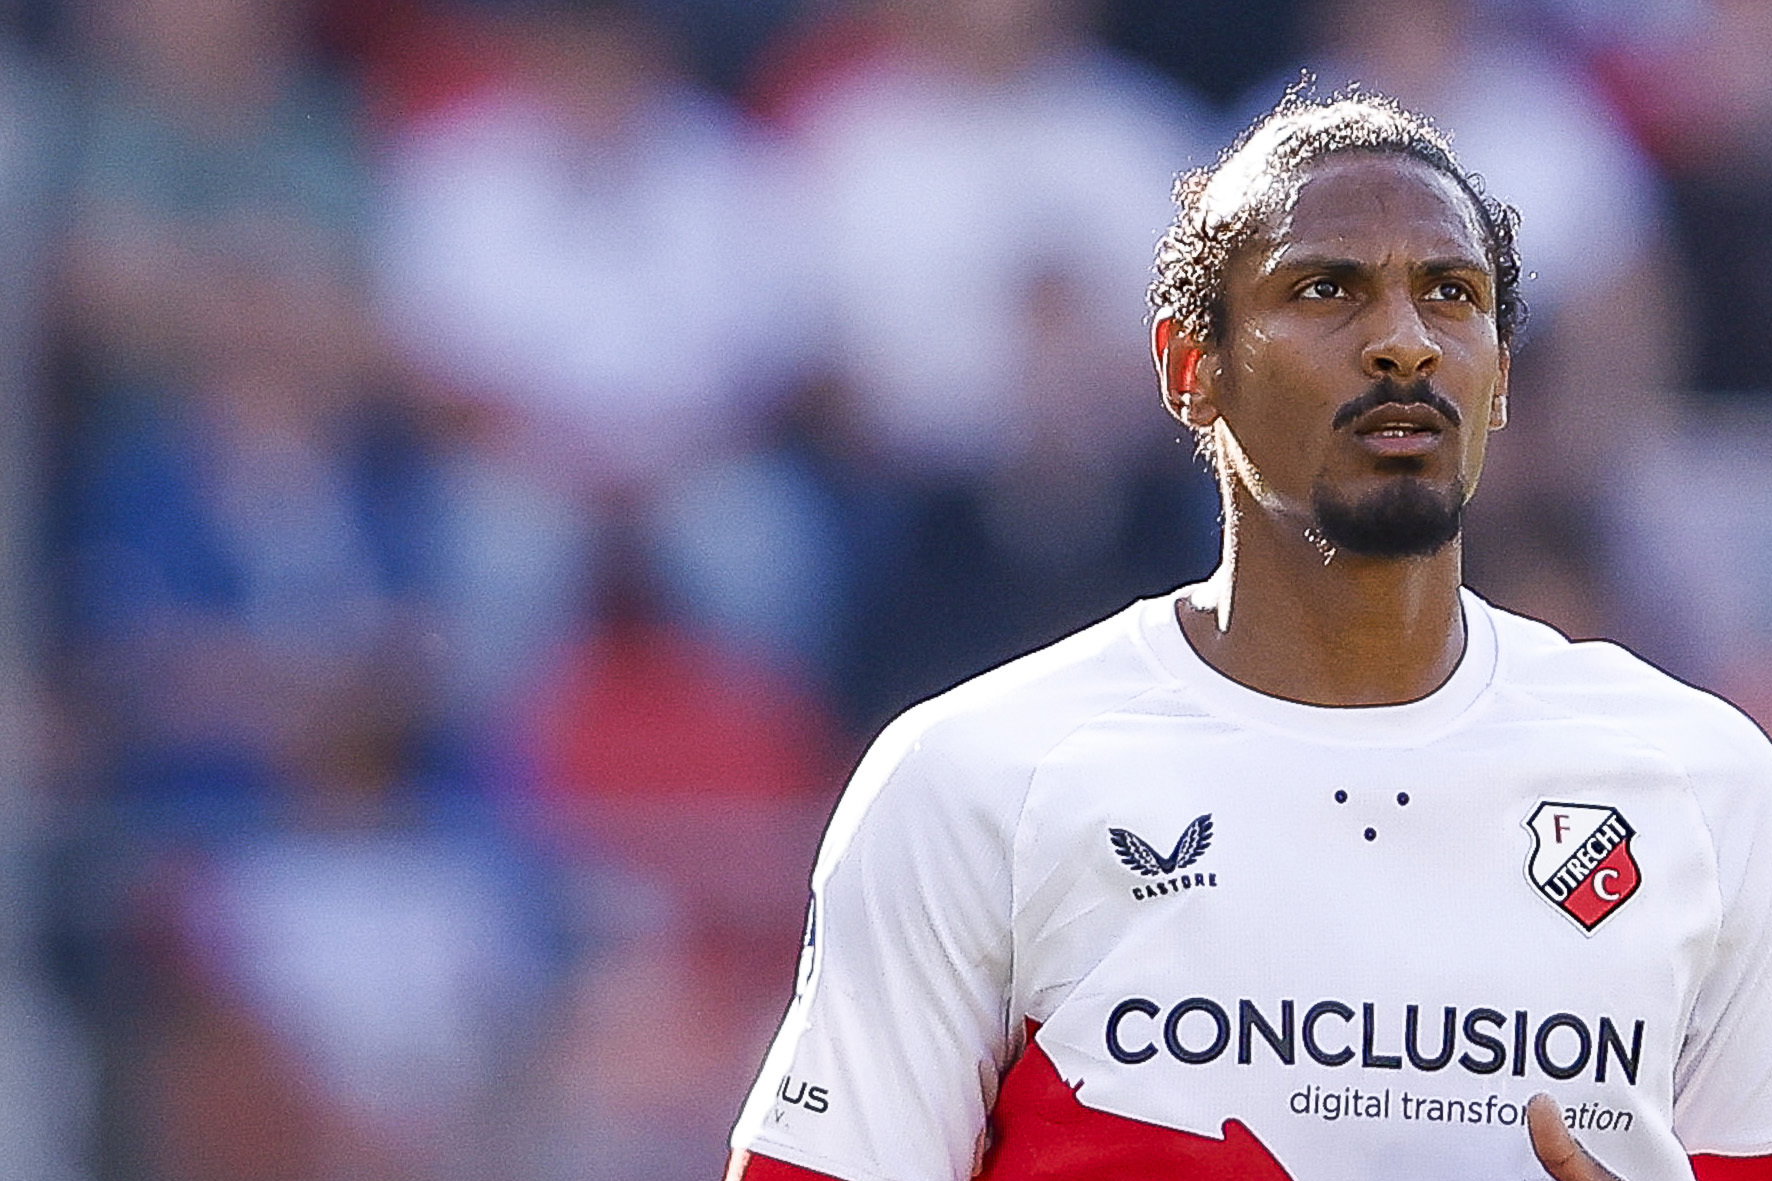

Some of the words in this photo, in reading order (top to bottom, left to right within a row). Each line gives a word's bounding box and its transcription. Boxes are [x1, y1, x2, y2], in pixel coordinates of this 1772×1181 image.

[1553, 814, 1571, 844] F
[1544, 814, 1627, 903] UTRECHT
[1132, 872, 1218, 901] CASTORE
[1593, 868, 1622, 902] C
[1105, 997, 1646, 1086] CONCLUSION
[1289, 1084, 1390, 1121] digital
[1402, 1091, 1634, 1132] transforation
